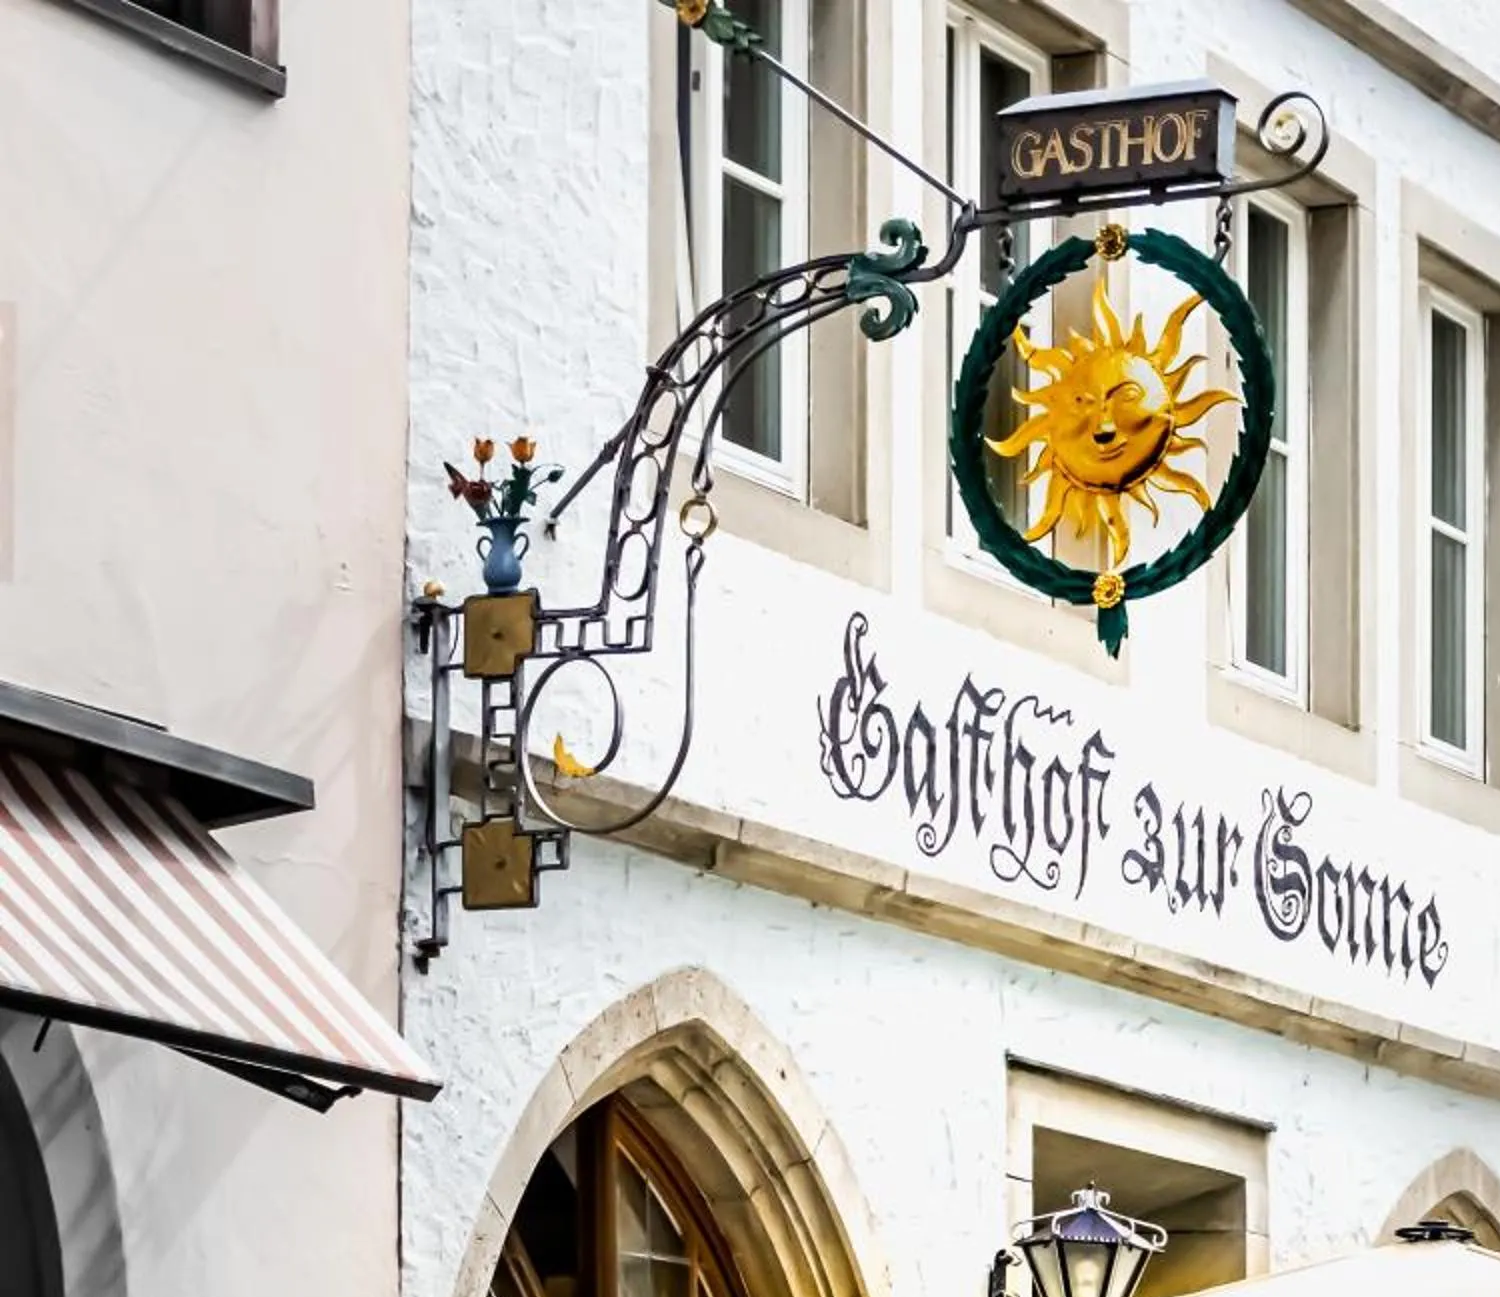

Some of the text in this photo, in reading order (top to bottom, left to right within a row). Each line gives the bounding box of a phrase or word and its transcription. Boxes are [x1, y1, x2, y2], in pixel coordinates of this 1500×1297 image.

[1011, 109, 1210, 178] GASTHOF
[817, 611, 1449, 988] Gasthof zur Sonne
